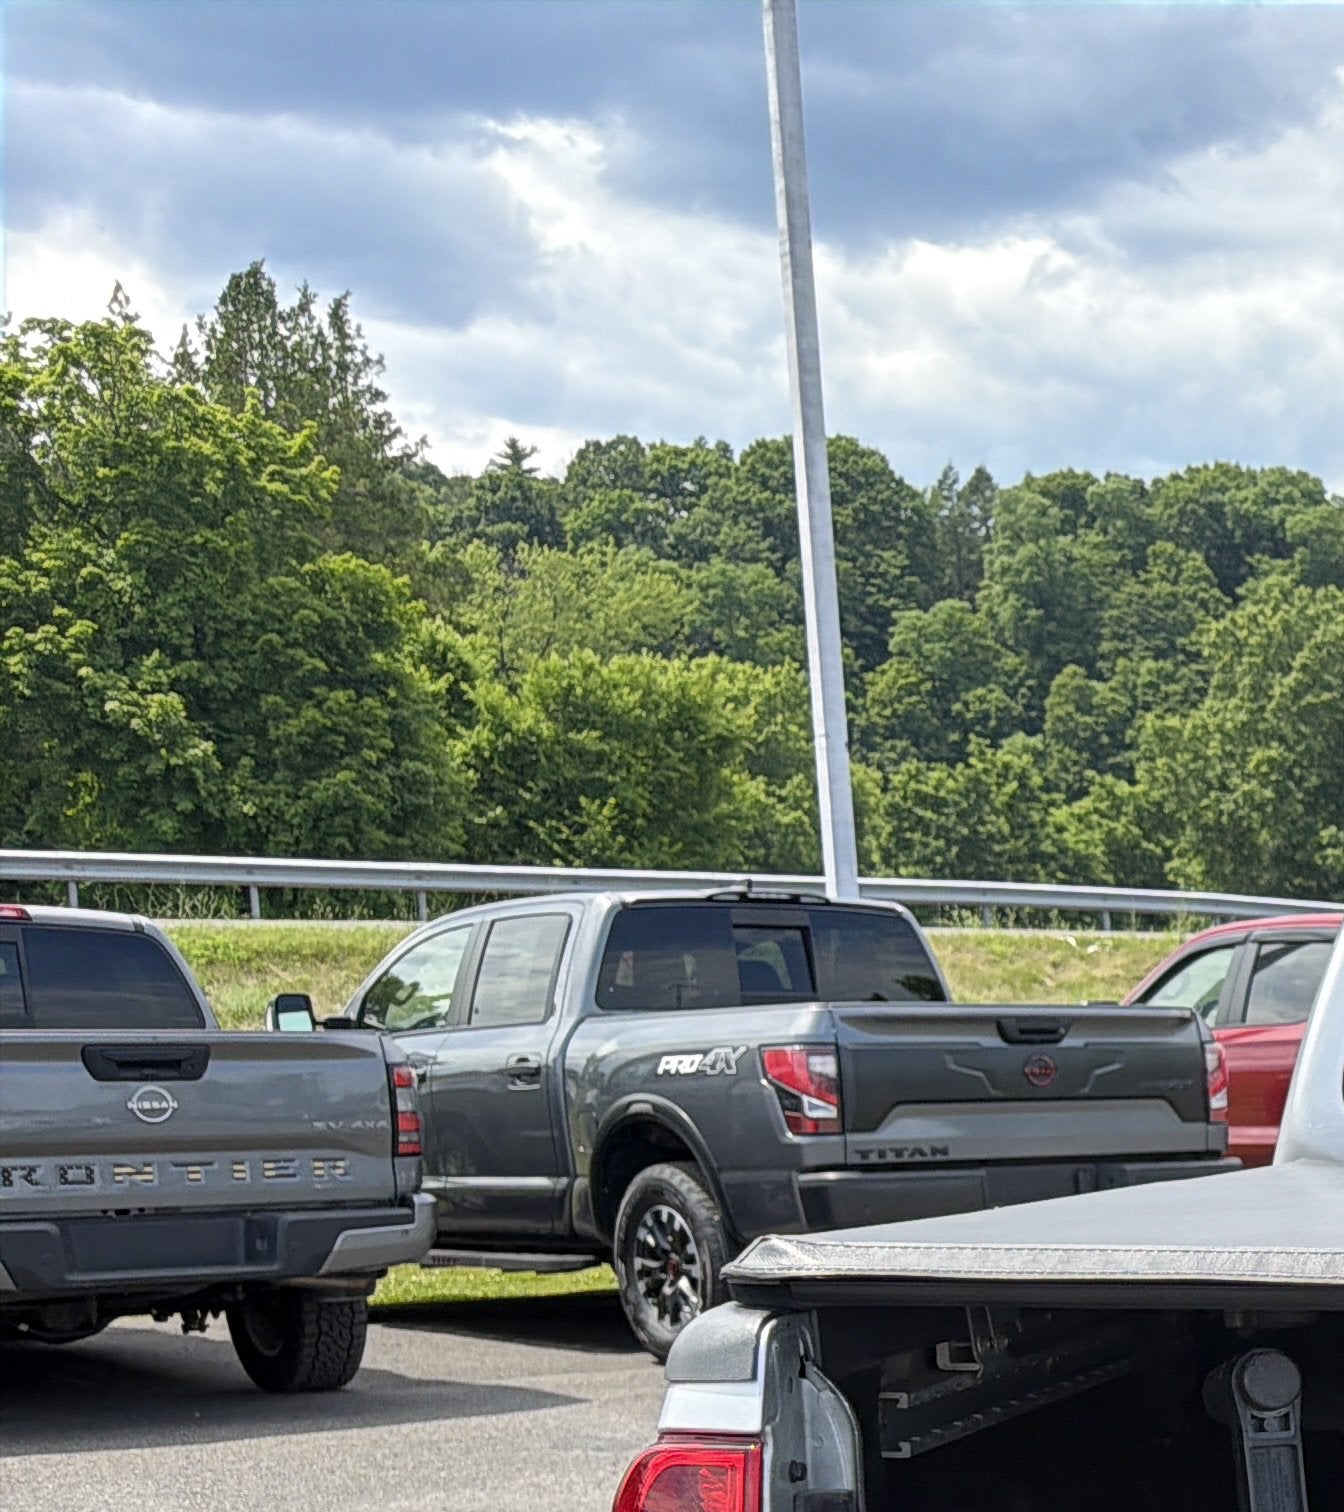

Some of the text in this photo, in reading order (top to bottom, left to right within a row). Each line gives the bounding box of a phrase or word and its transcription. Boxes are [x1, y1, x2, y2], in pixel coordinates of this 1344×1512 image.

[127, 1100, 178, 1110] NISSAN
[854, 1144, 949, 1160] TITAN
[0, 1157, 347, 1187] RONTIER
